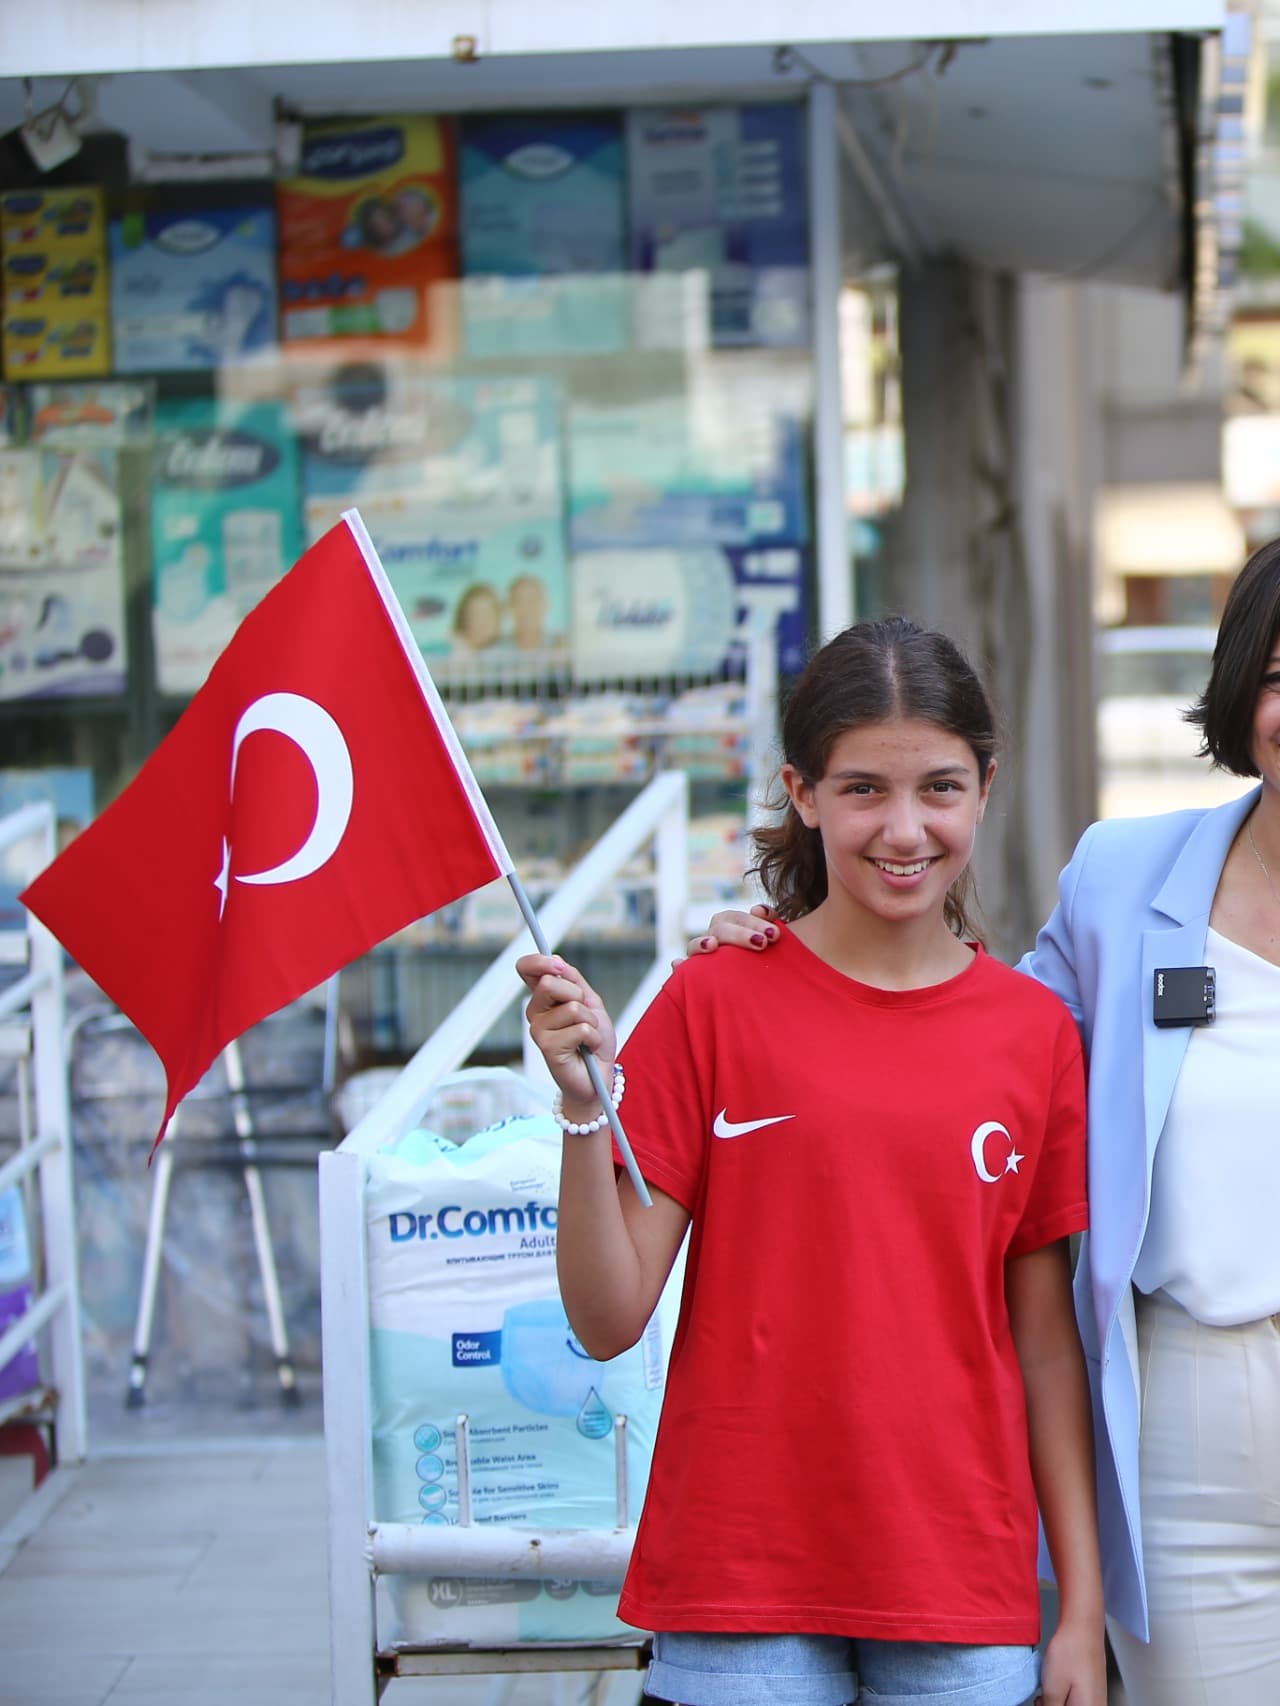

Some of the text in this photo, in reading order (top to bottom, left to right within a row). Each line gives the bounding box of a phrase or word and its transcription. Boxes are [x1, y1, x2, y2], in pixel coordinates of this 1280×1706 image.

[456, 1339, 480, 1350] Odor
[456, 1350, 492, 1361] Control
[512, 1423, 549, 1433] Particles
[492, 1455, 515, 1464] Waist
[517, 1453, 537, 1462] Area
[497, 1484, 535, 1493] Sensitive
[537, 1481, 560, 1490] Skins
[431, 1583, 457, 1601] XL
